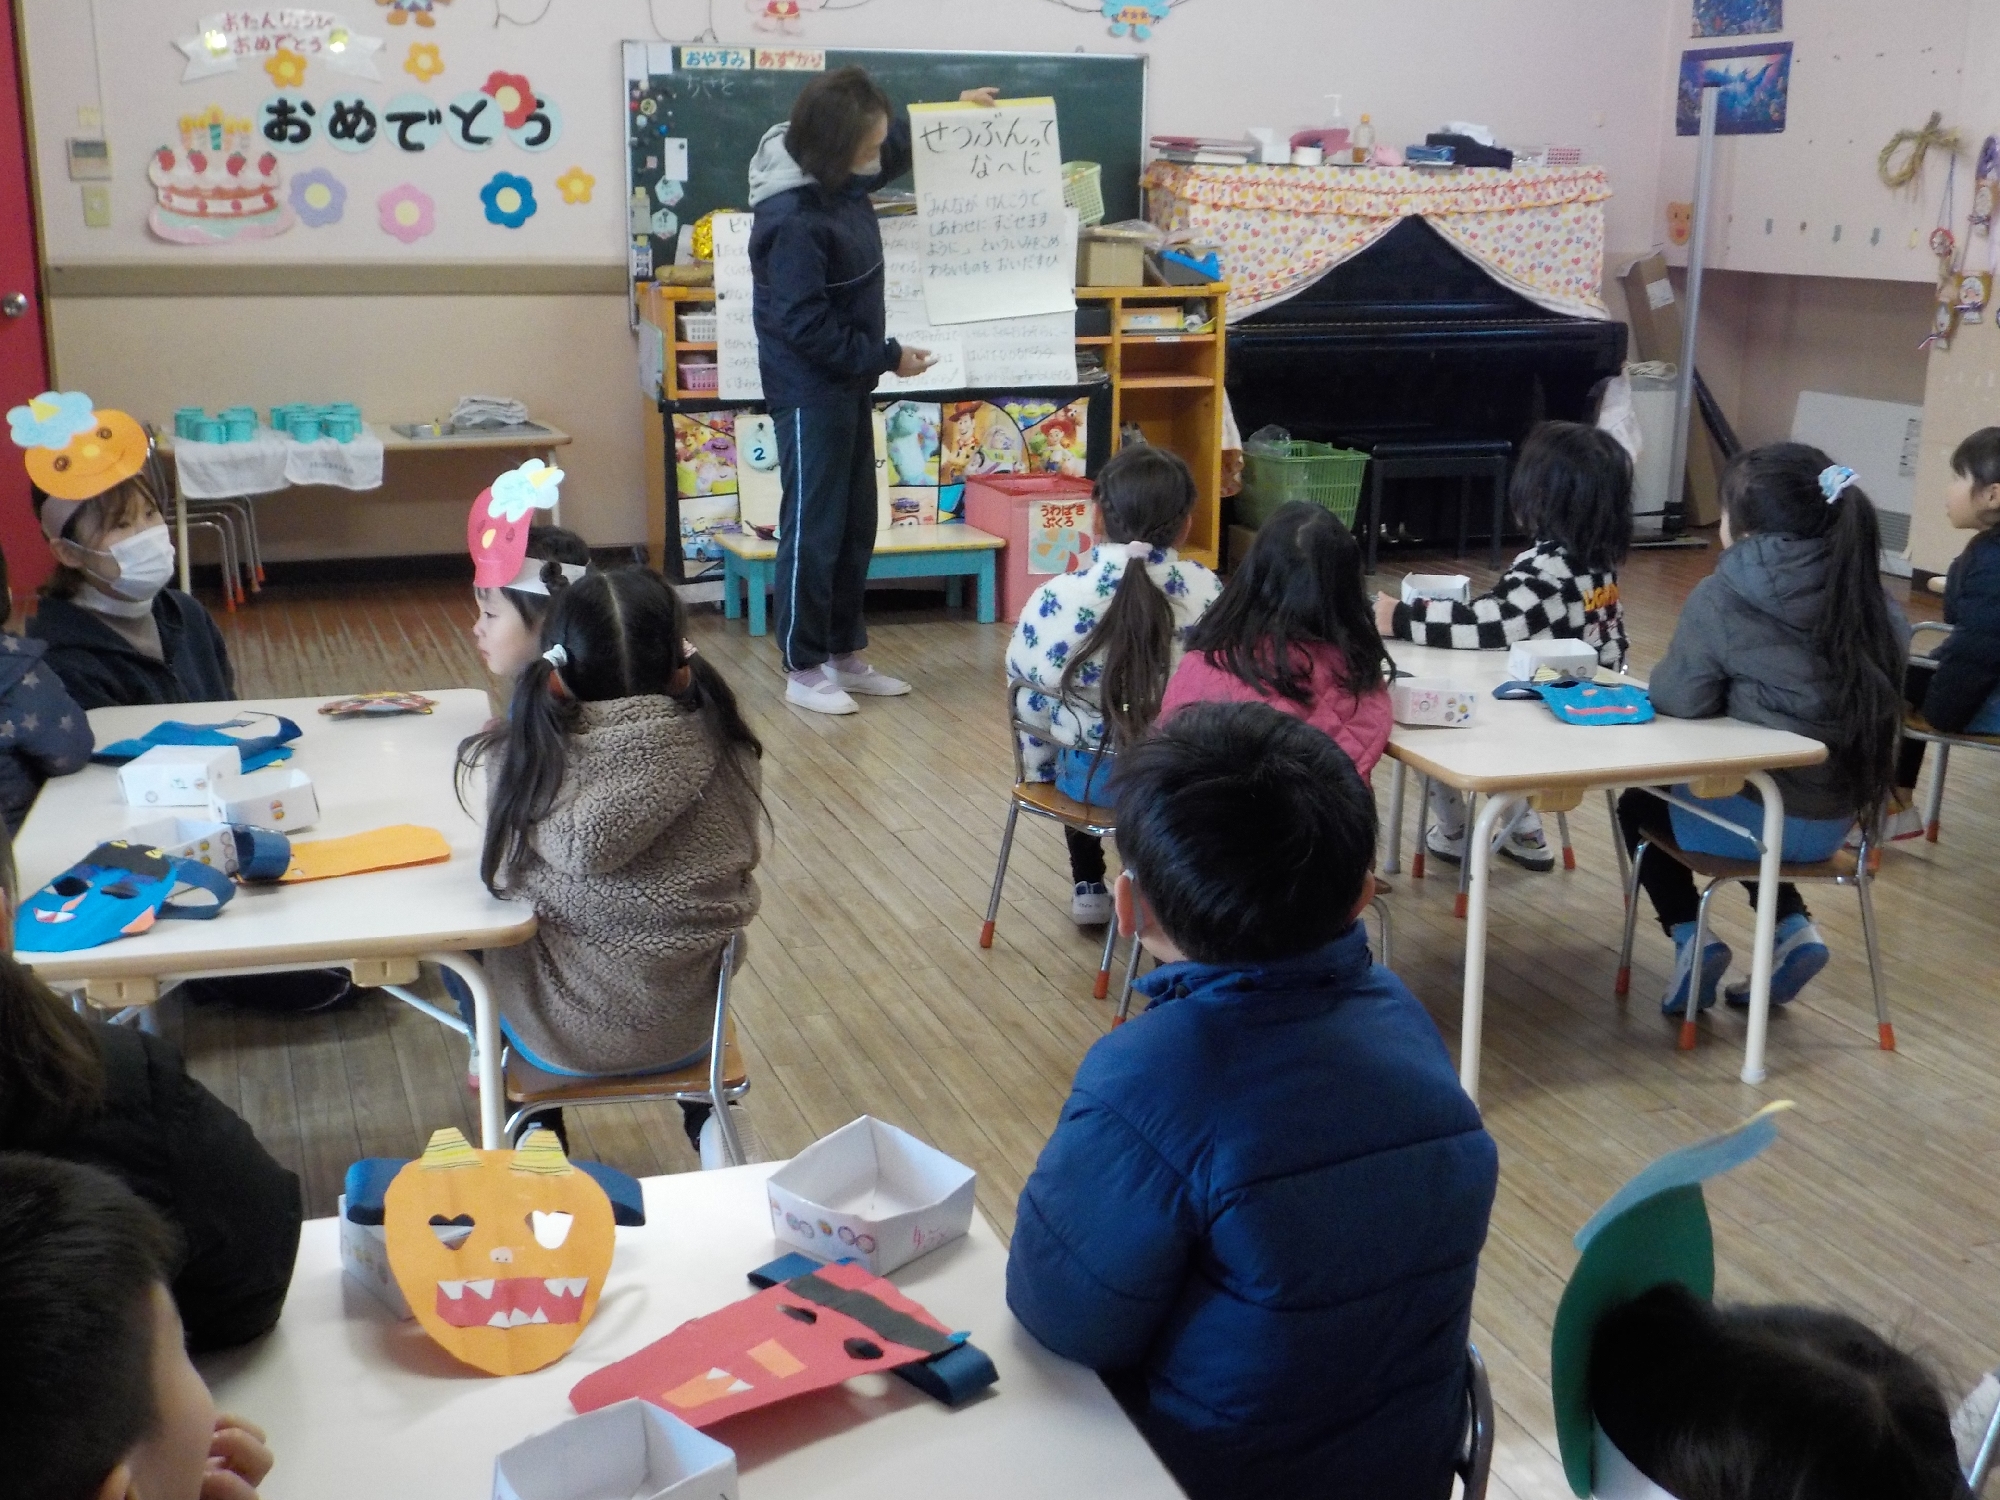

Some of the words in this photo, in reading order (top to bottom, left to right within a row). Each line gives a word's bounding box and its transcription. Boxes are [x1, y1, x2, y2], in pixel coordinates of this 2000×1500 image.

[685, 51, 746, 68] おやすみ
[757, 50, 824, 69] あずかり
[263, 97, 552, 151] おめでとう
[919, 111, 1054, 154] せつぶんって
[752, 447, 766, 462] 2
[1040, 503, 1086, 518] うわばき
[1042, 517, 1075, 529] ぶくろ
